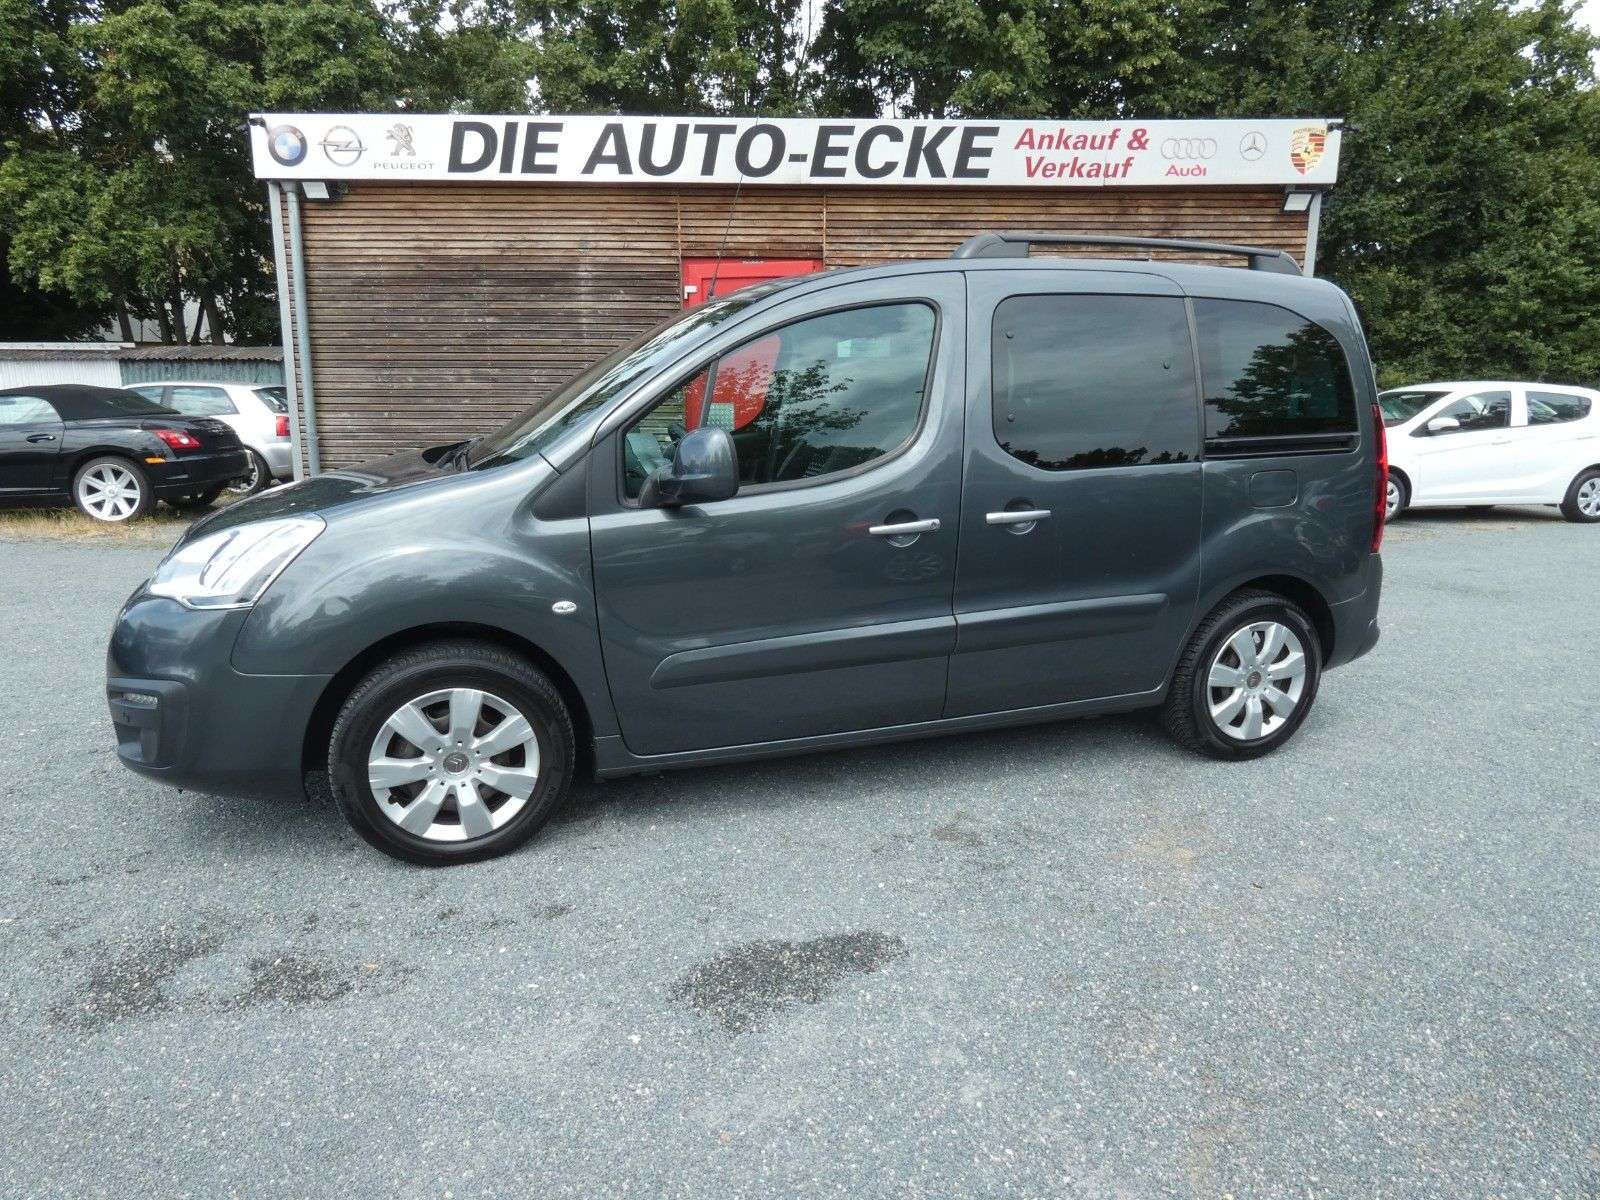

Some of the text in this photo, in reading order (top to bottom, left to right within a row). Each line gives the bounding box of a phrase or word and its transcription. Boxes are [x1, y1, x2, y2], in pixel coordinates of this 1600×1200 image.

[448, 121, 999, 178] DIE AUTO-ECKE
[1014, 128, 1149, 151] Ankauf &
[373, 162, 435, 170] PEUGEOT
[1025, 156, 1135, 178] Verkauf
[1165, 164, 1207, 177] Audi
